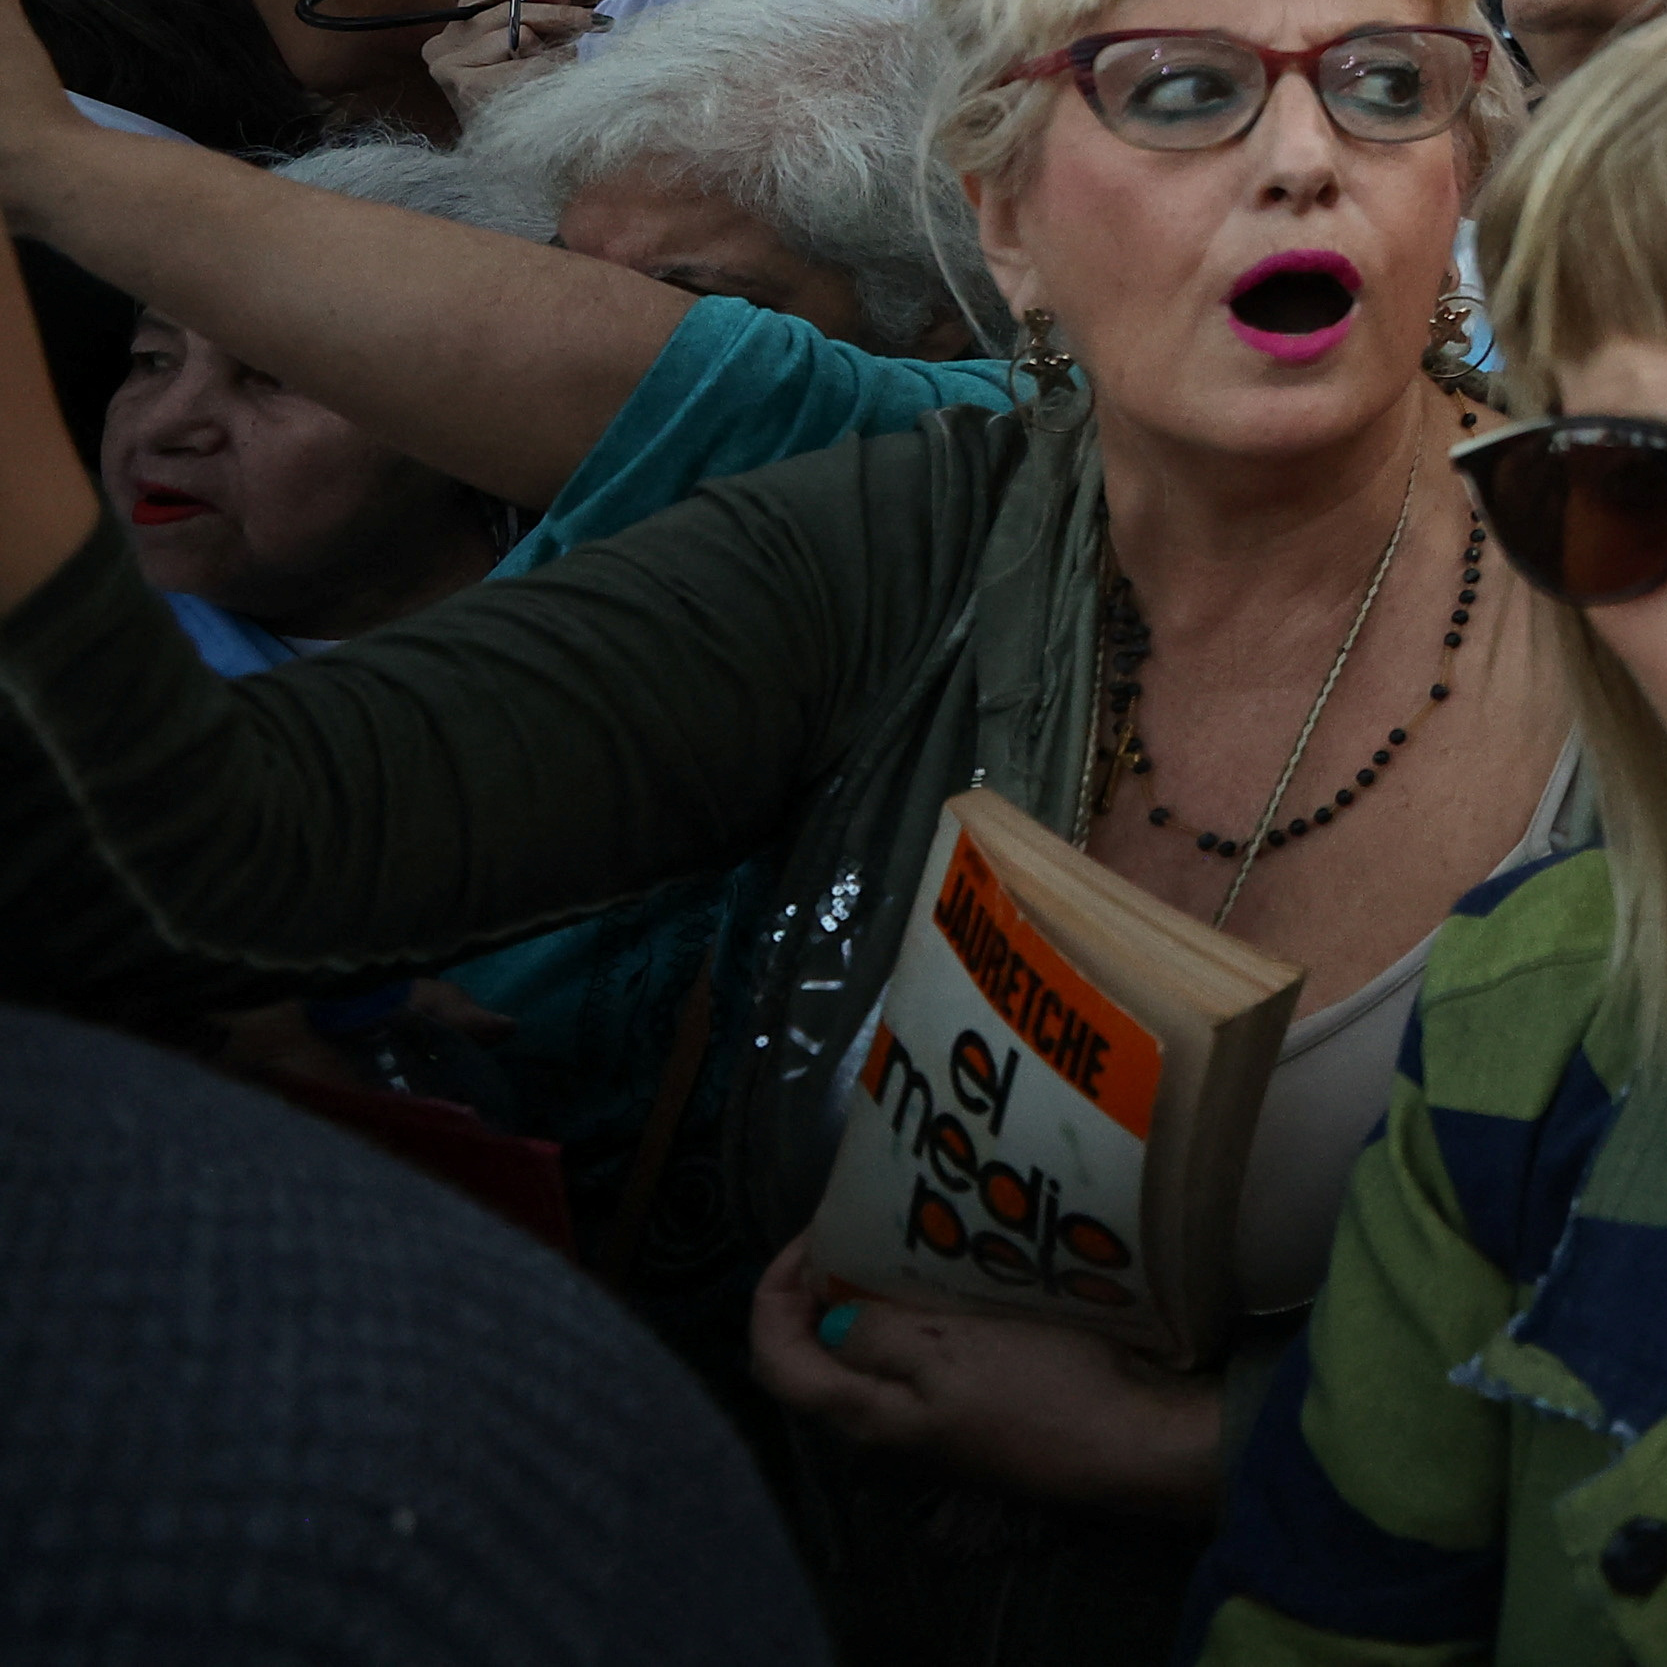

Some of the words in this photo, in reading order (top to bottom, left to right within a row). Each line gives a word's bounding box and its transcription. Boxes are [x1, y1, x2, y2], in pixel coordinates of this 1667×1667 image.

[934, 872, 1113, 1099] JAURETCHE
[949, 1028, 1020, 1137] el
[876, 1037, 1132, 1270] medio
